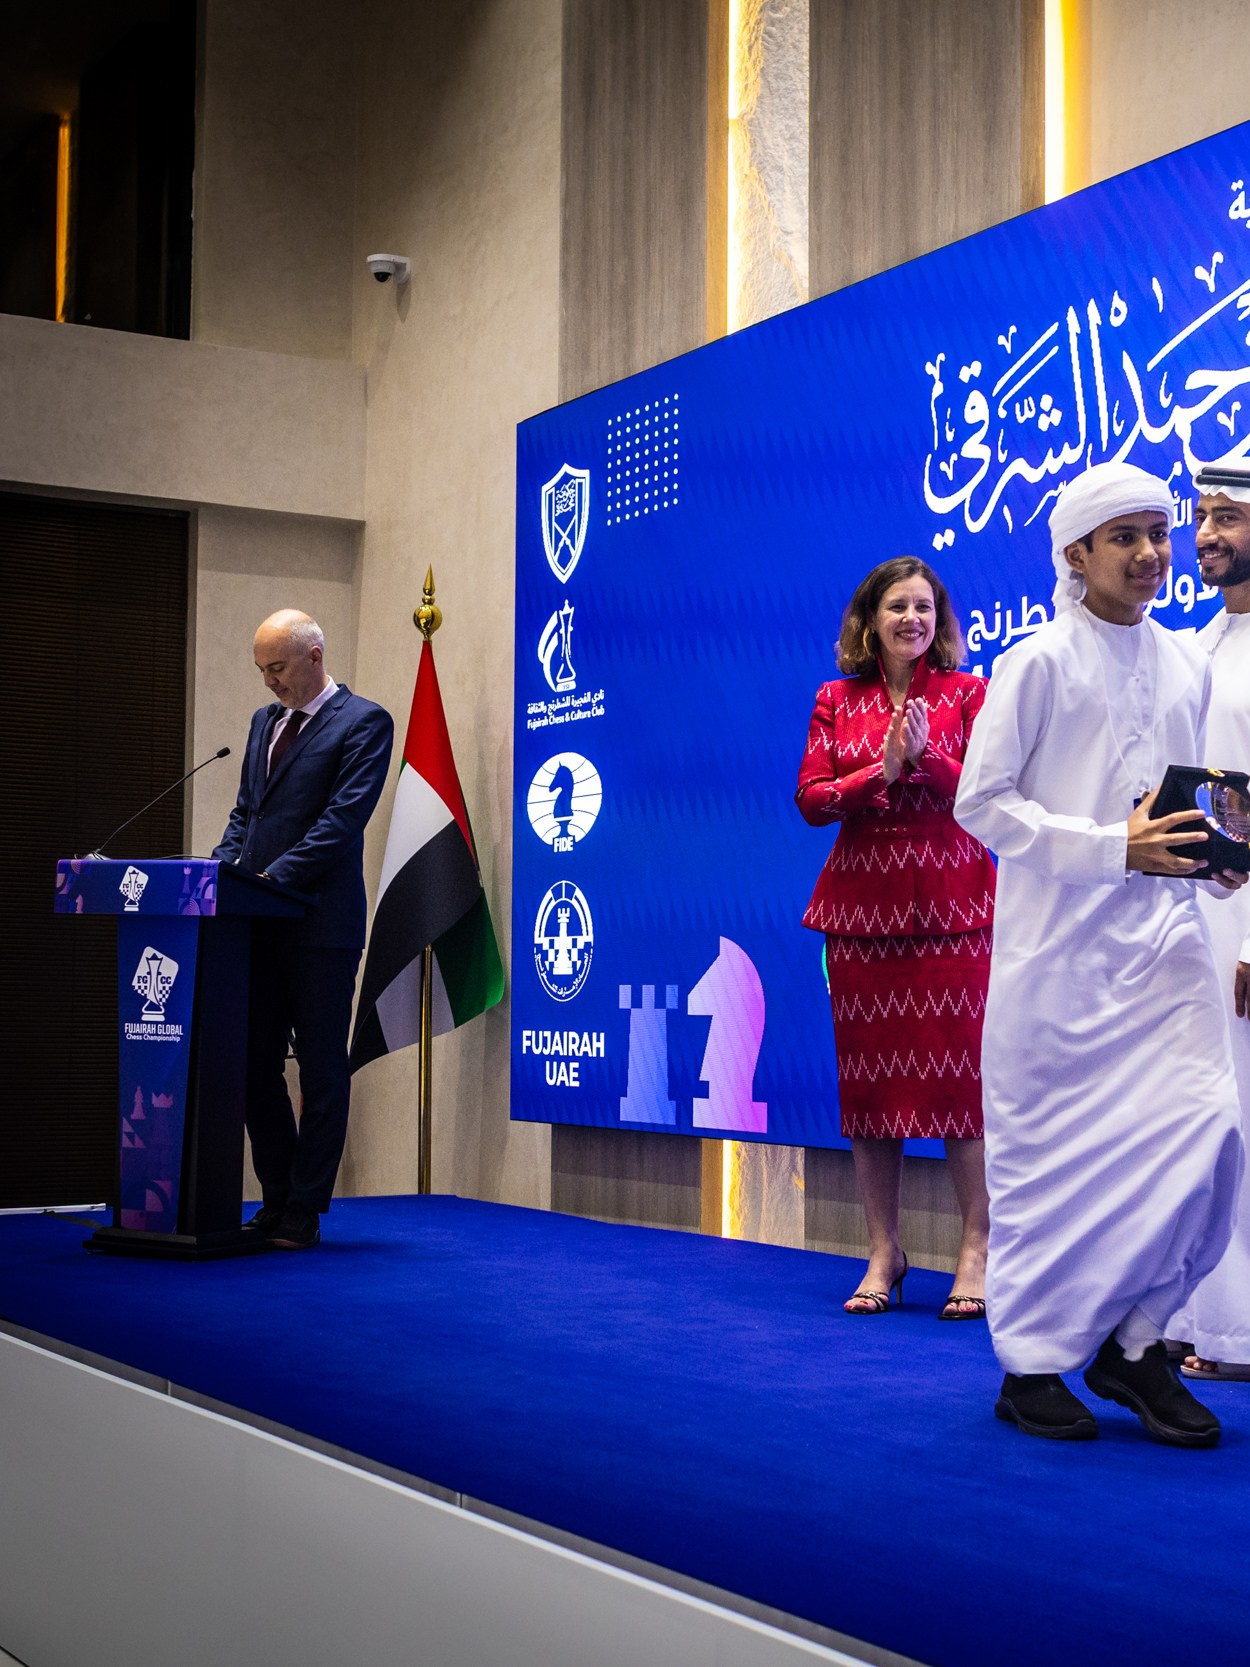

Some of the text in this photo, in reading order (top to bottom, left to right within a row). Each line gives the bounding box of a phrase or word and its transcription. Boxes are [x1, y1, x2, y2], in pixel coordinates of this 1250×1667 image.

[966, 595, 1055, 652] طرنج
[527, 715, 549, 731] Fujairah
[549, 714, 565, 725] Chess
[570, 709, 592, 721] Culture
[592, 704, 605, 717] Club
[553, 836, 574, 853] FIDE
[137, 975, 172, 985] FG CC
[124, 1023, 184, 1036] FUJAIRAH GLOBAL
[143, 1033, 181, 1043] Championship
[522, 1030, 605, 1058] FUJAIRAH
[545, 1060, 580, 1088] UAE
